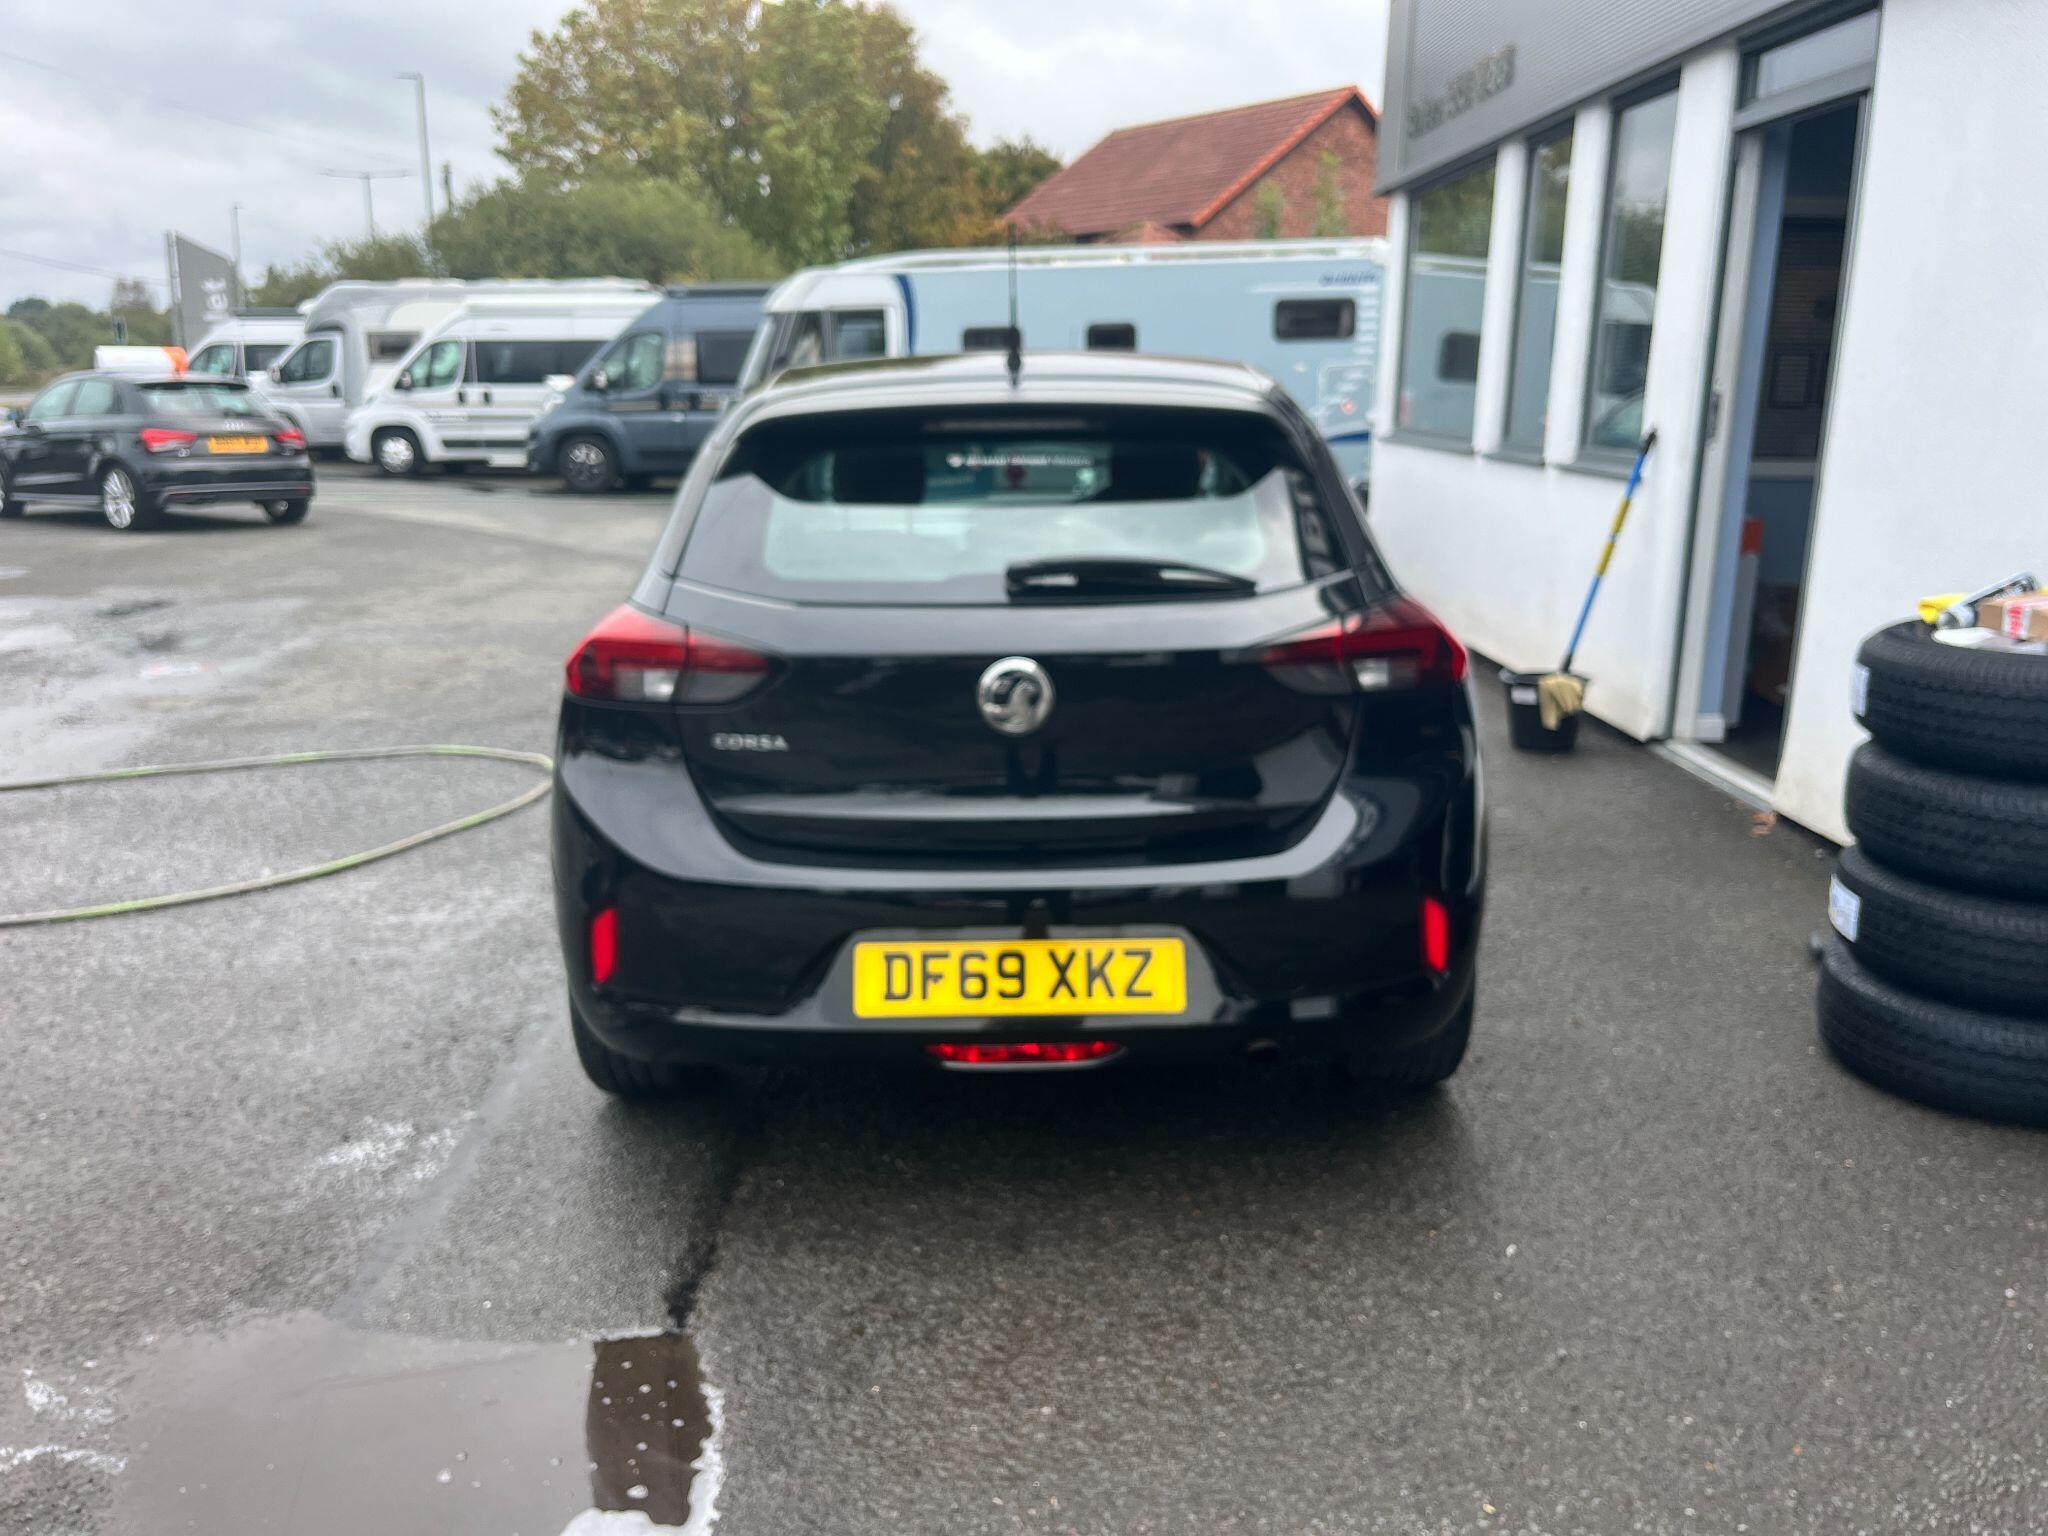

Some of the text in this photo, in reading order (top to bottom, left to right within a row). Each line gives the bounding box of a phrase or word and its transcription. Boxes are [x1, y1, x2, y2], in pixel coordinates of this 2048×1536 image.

[711, 732, 790, 752] CORSA
[883, 948, 1154, 1001] DF69 XKZ
